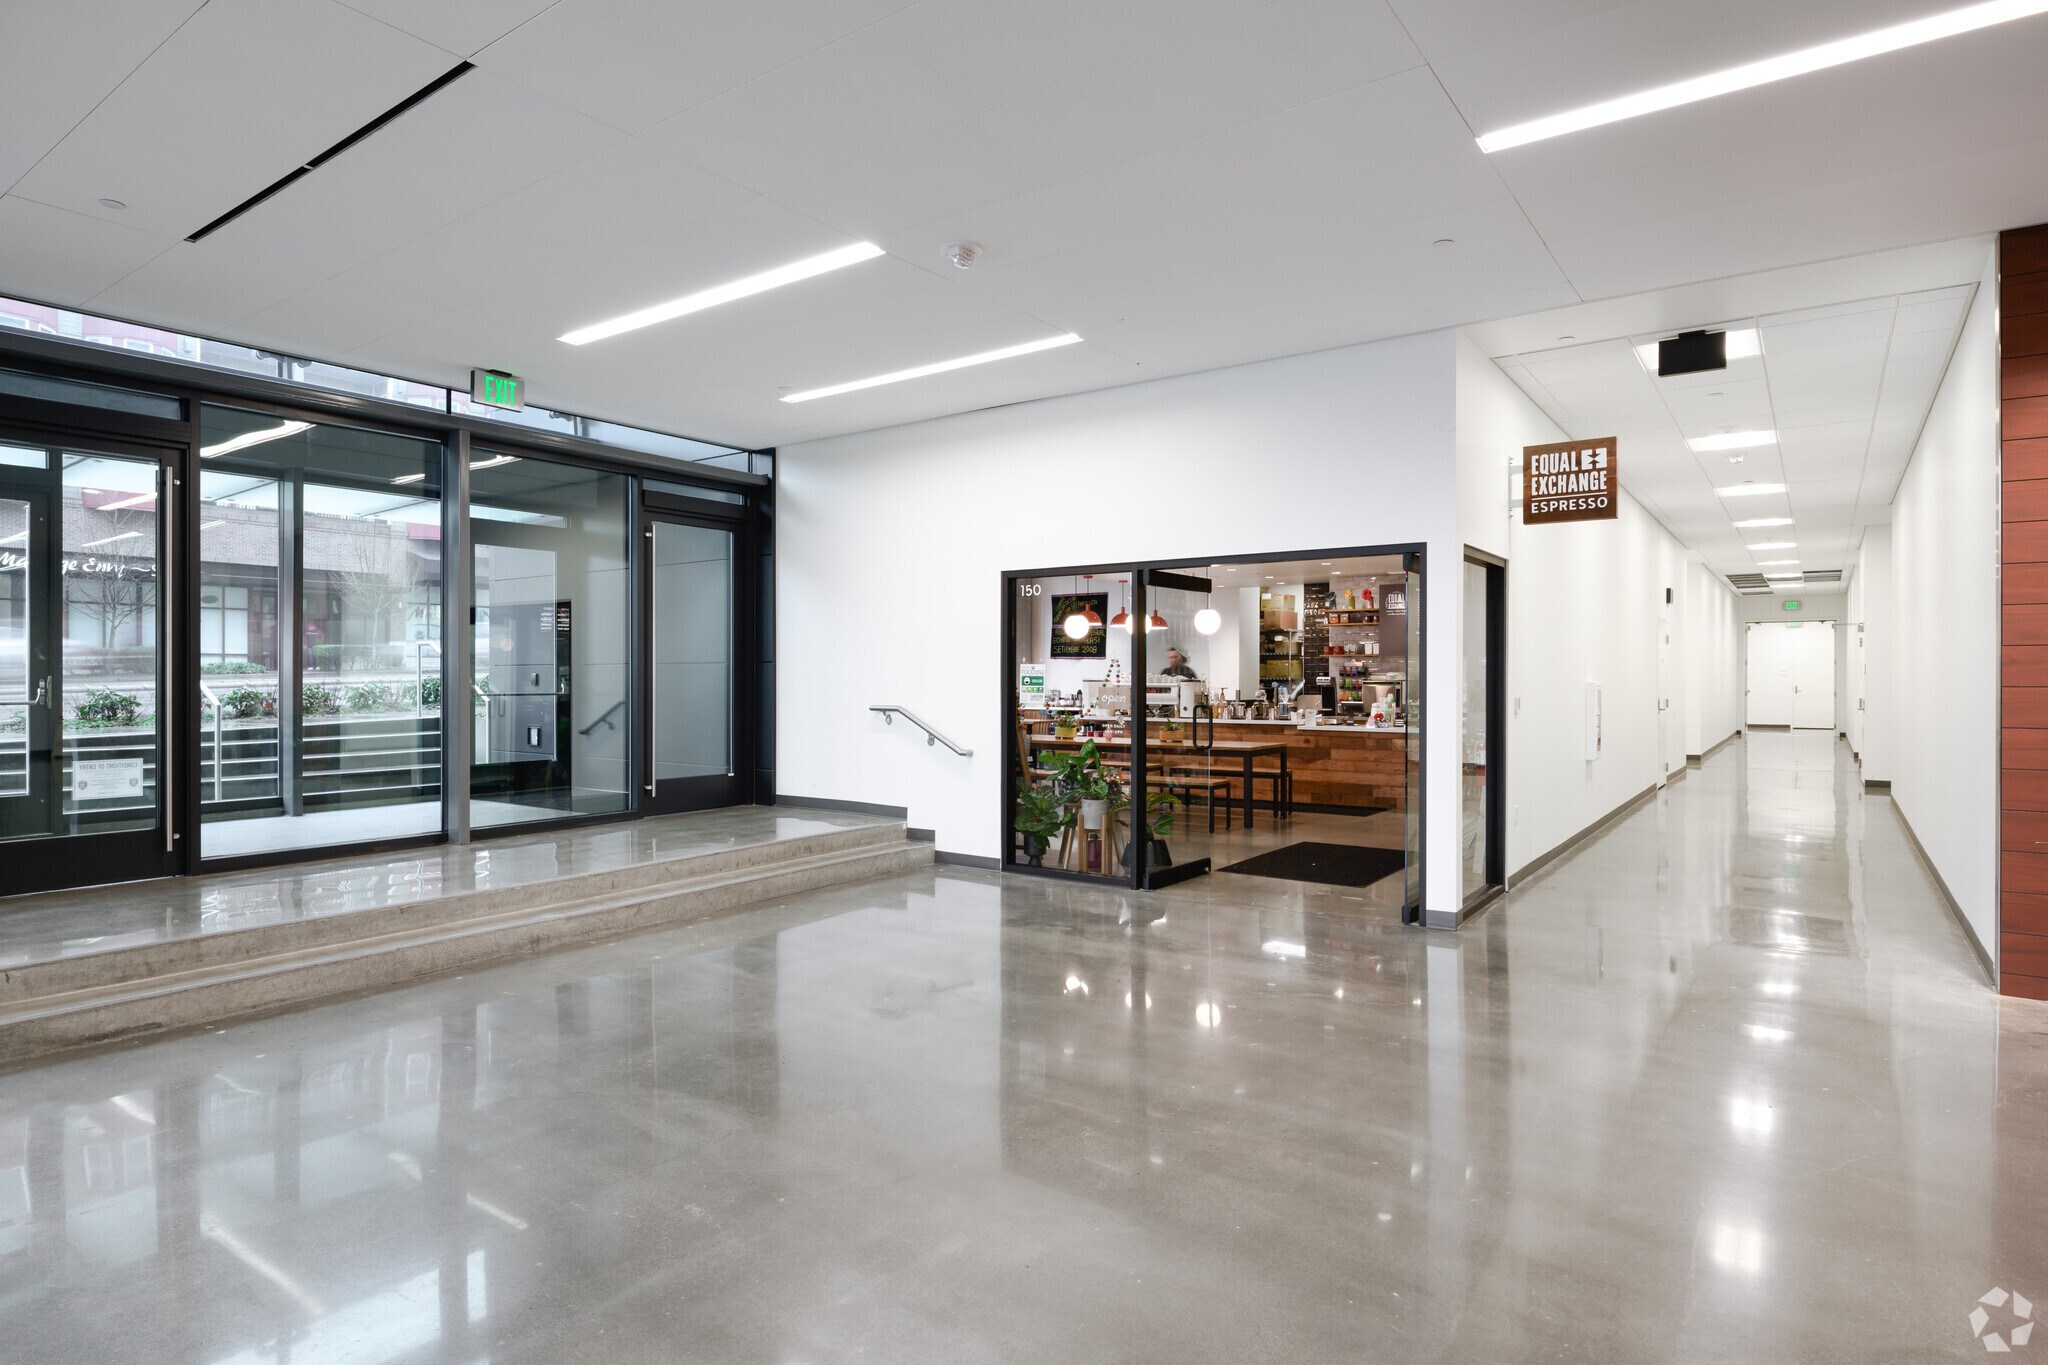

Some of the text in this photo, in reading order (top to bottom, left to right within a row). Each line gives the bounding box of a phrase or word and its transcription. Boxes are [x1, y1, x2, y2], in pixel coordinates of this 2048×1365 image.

[485, 375, 517, 406] EXIT
[1531, 451, 1578, 475] EQUAL
[1531, 471, 1607, 496] EXCHANGE
[1531, 497, 1608, 514] ESPRESSO
[82, 558, 125, 578] Envy
[1020, 584, 1041, 597] 150
[1388, 593, 1405, 603] EQUAL
[1786, 601, 1799, 610] EXIT
[1082, 645, 1097, 654] 2008
[1101, 694, 1126, 705] open
